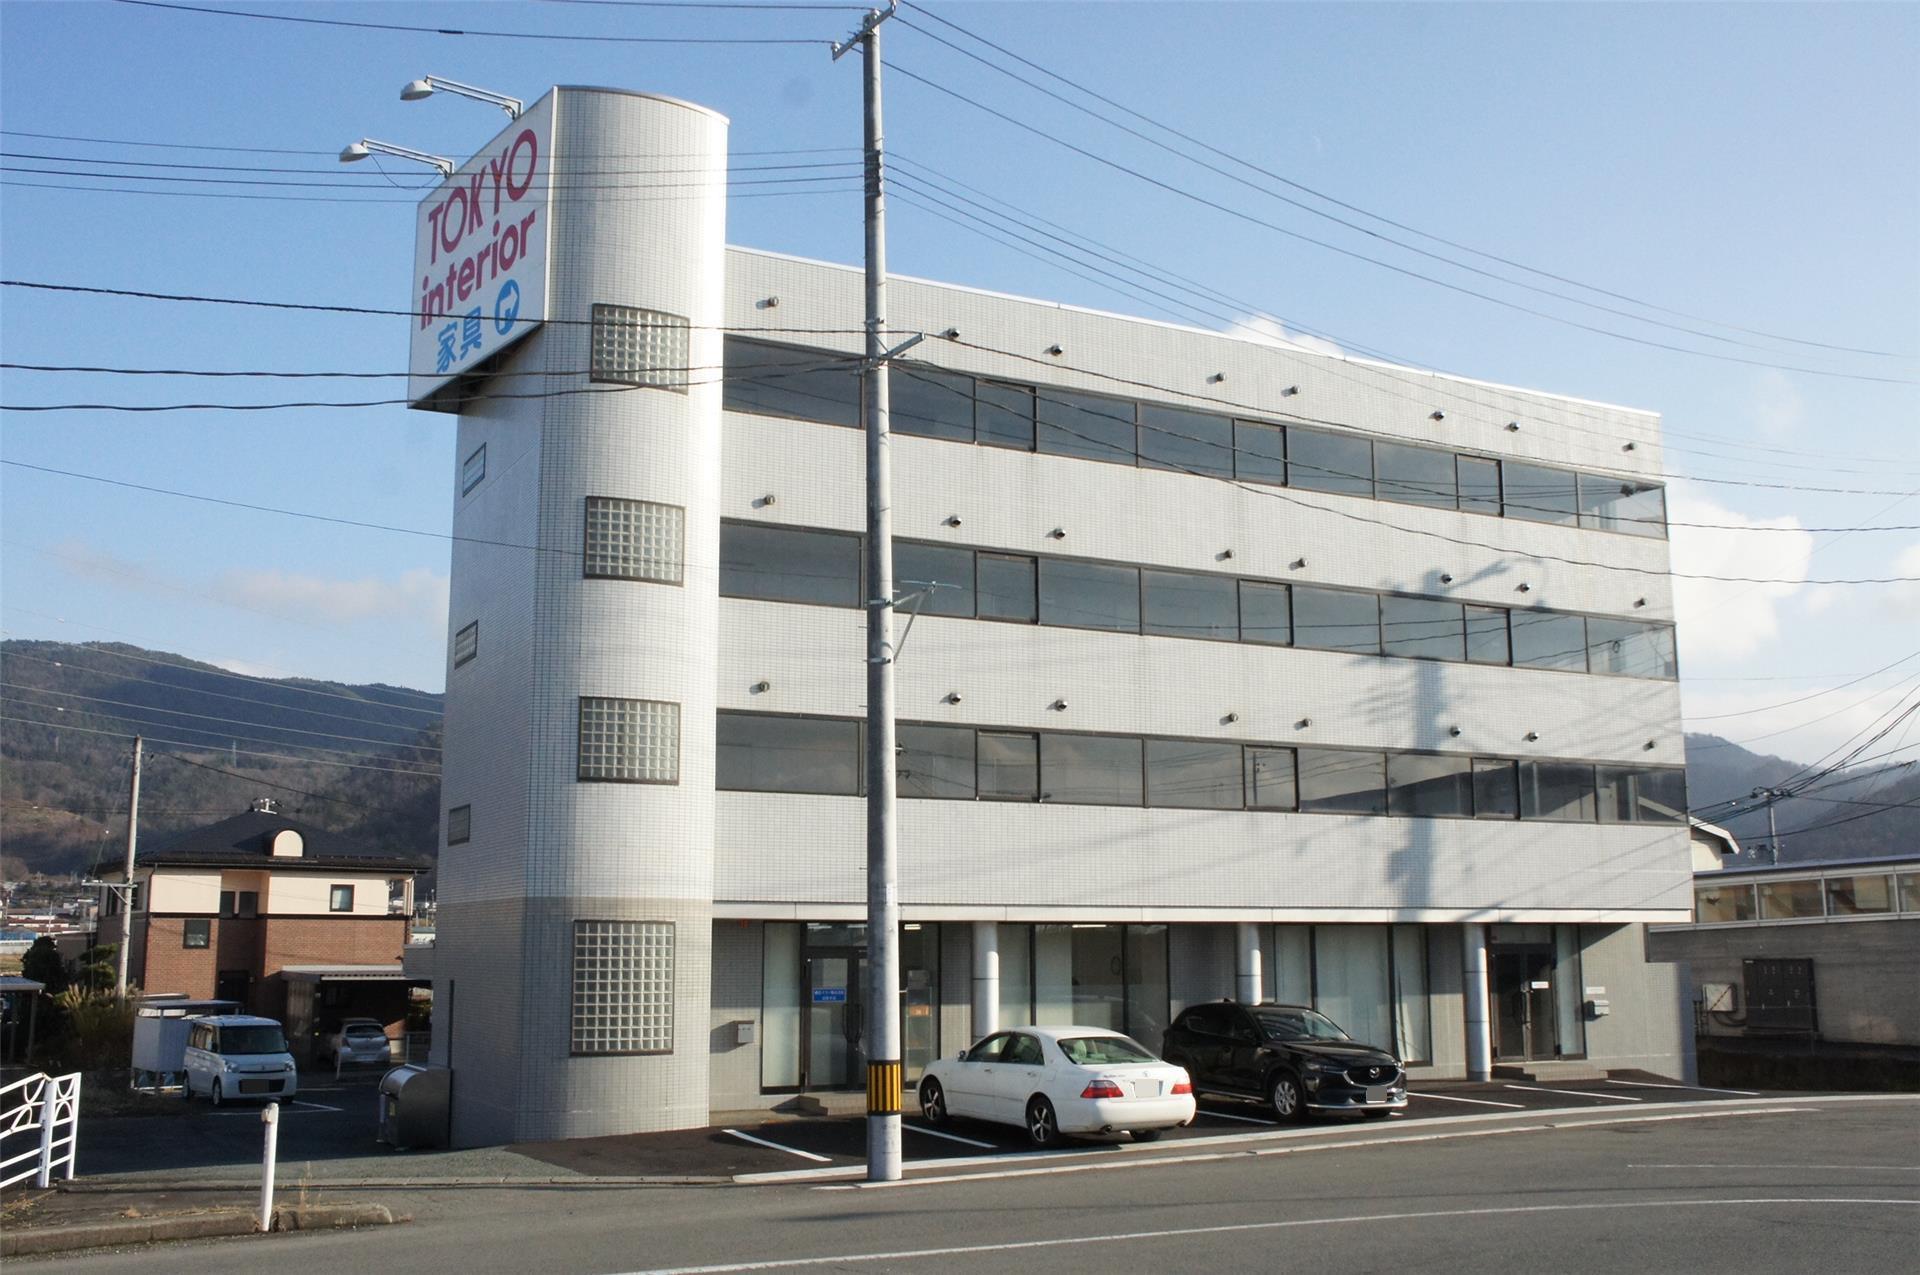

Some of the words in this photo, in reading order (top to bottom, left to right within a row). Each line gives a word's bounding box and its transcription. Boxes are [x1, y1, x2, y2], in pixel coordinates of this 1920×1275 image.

[428, 128, 538, 265] TOKYO
[420, 208, 536, 331] interior
[436, 305, 482, 374] 家具
